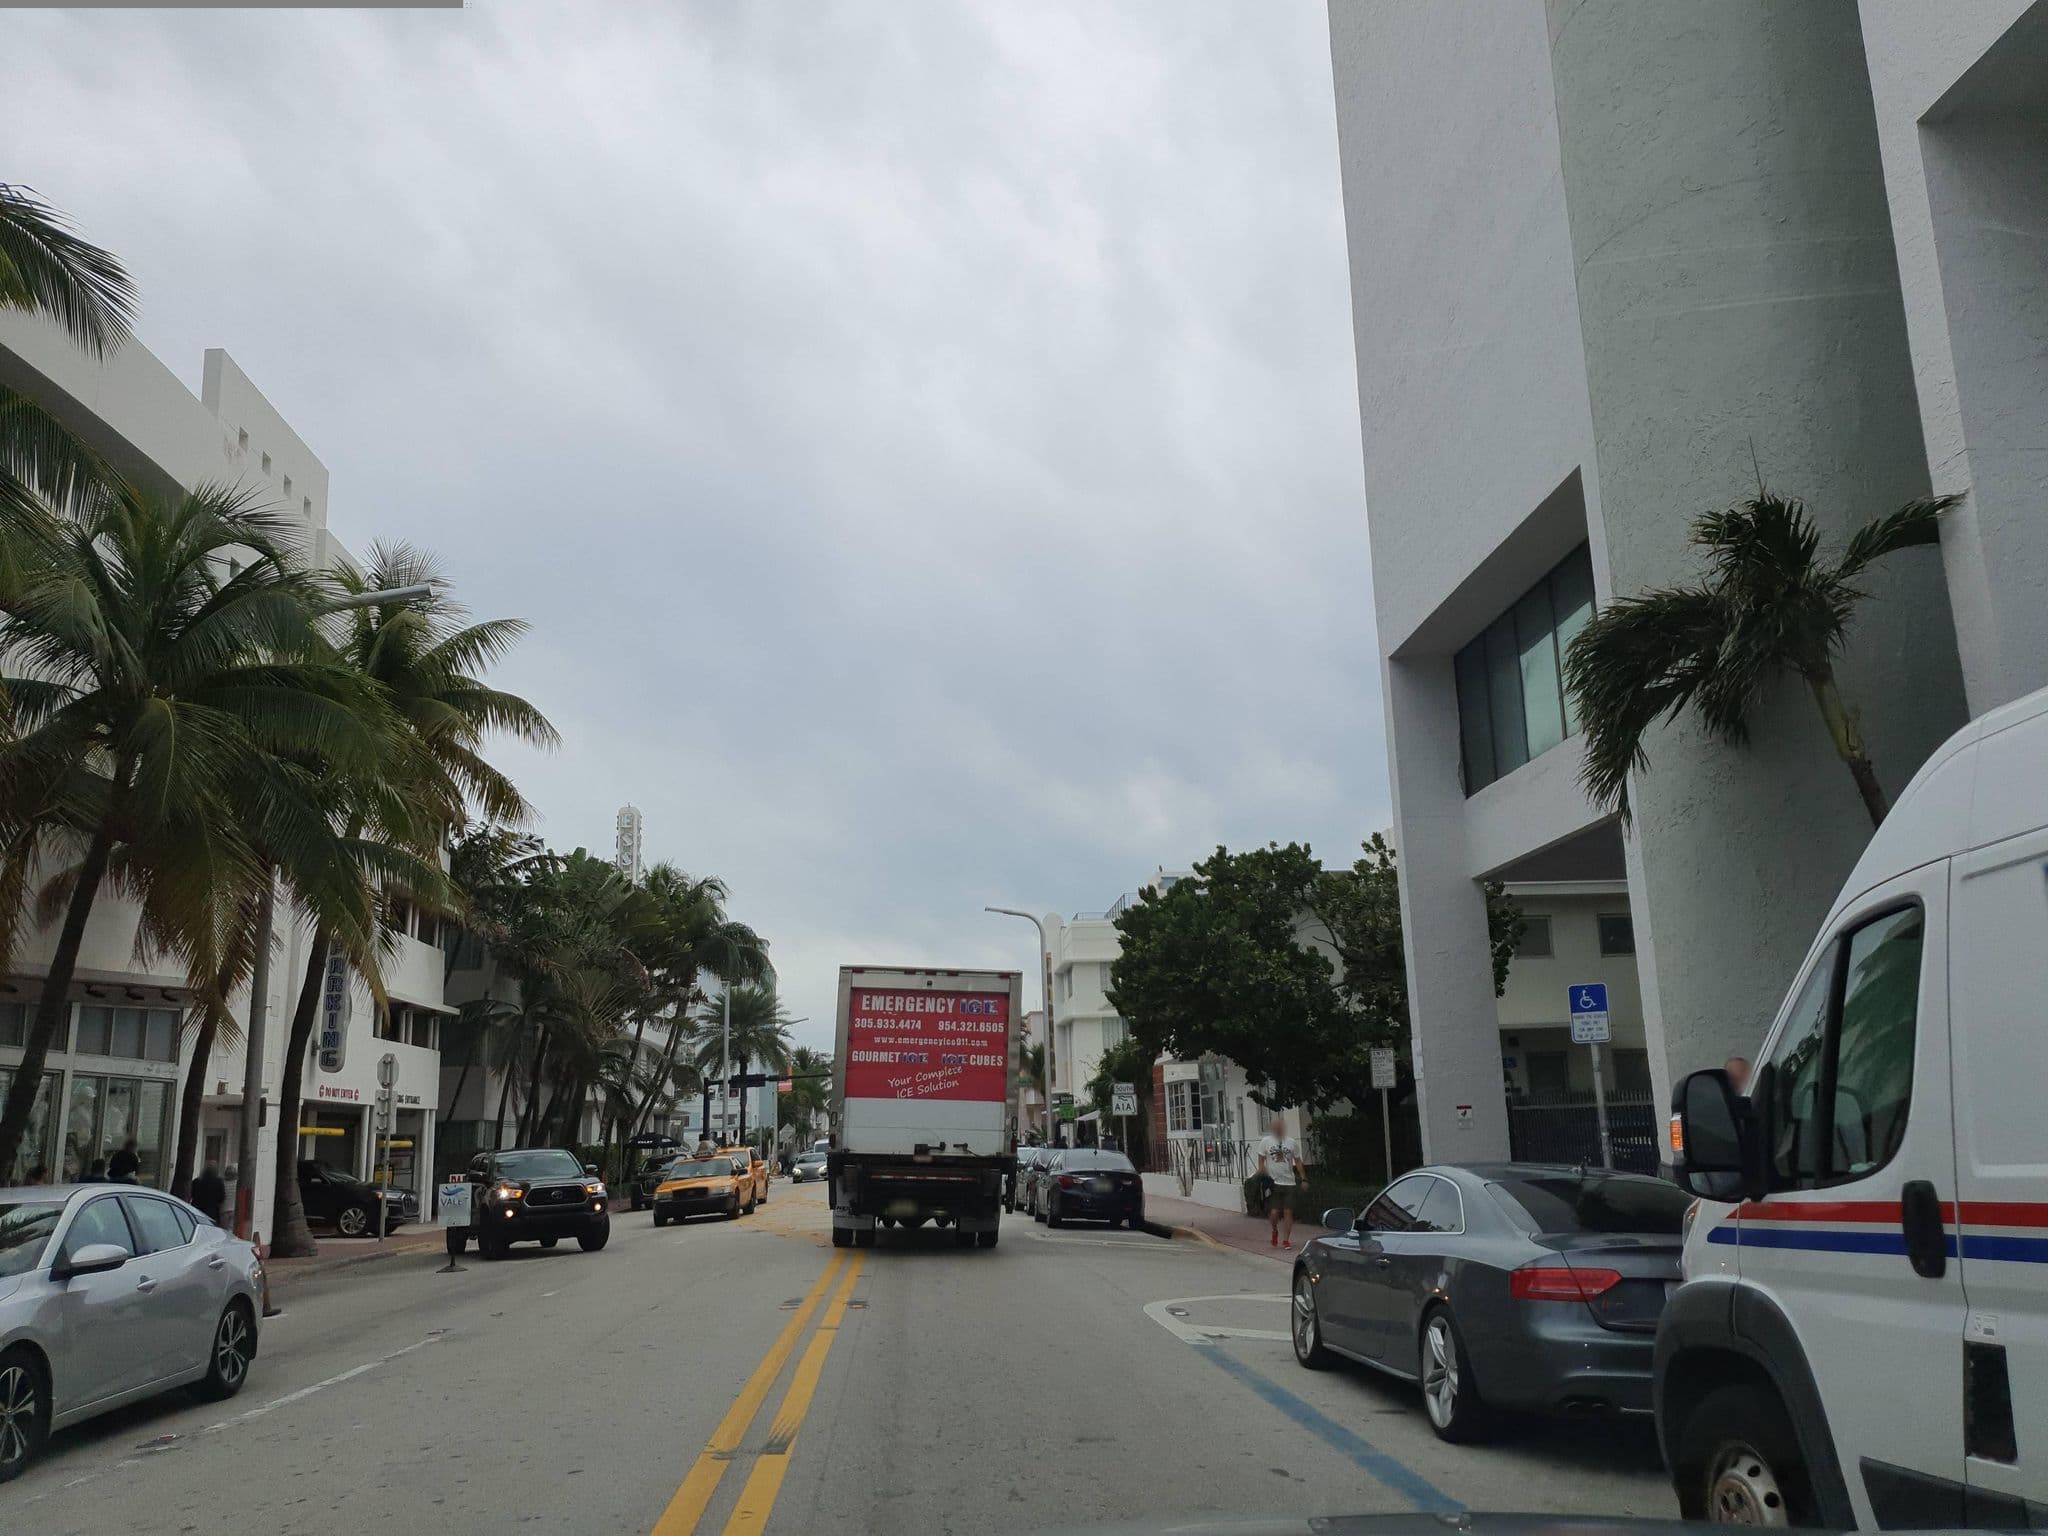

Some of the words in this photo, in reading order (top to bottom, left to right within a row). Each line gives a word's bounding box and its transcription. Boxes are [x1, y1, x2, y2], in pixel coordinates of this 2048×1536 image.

[861, 994, 956, 1013] EMERGENCY
[959, 999, 999, 1015] ICE
[854, 1018, 922, 1030] 305.933.4474
[852, 1051, 900, 1063] GOURMET
[901, 1052, 928, 1064] ICE
[941, 1053, 967, 1065] ICE
[969, 1054, 1004, 1066] CUBES
[888, 1074, 913, 1088] Your
[915, 1065, 963, 1082] Complete
[896, 1087, 914, 1099] ICE
[917, 1079, 960, 1095] Solution
[1115, 1084, 1134, 1093] SOUTH
